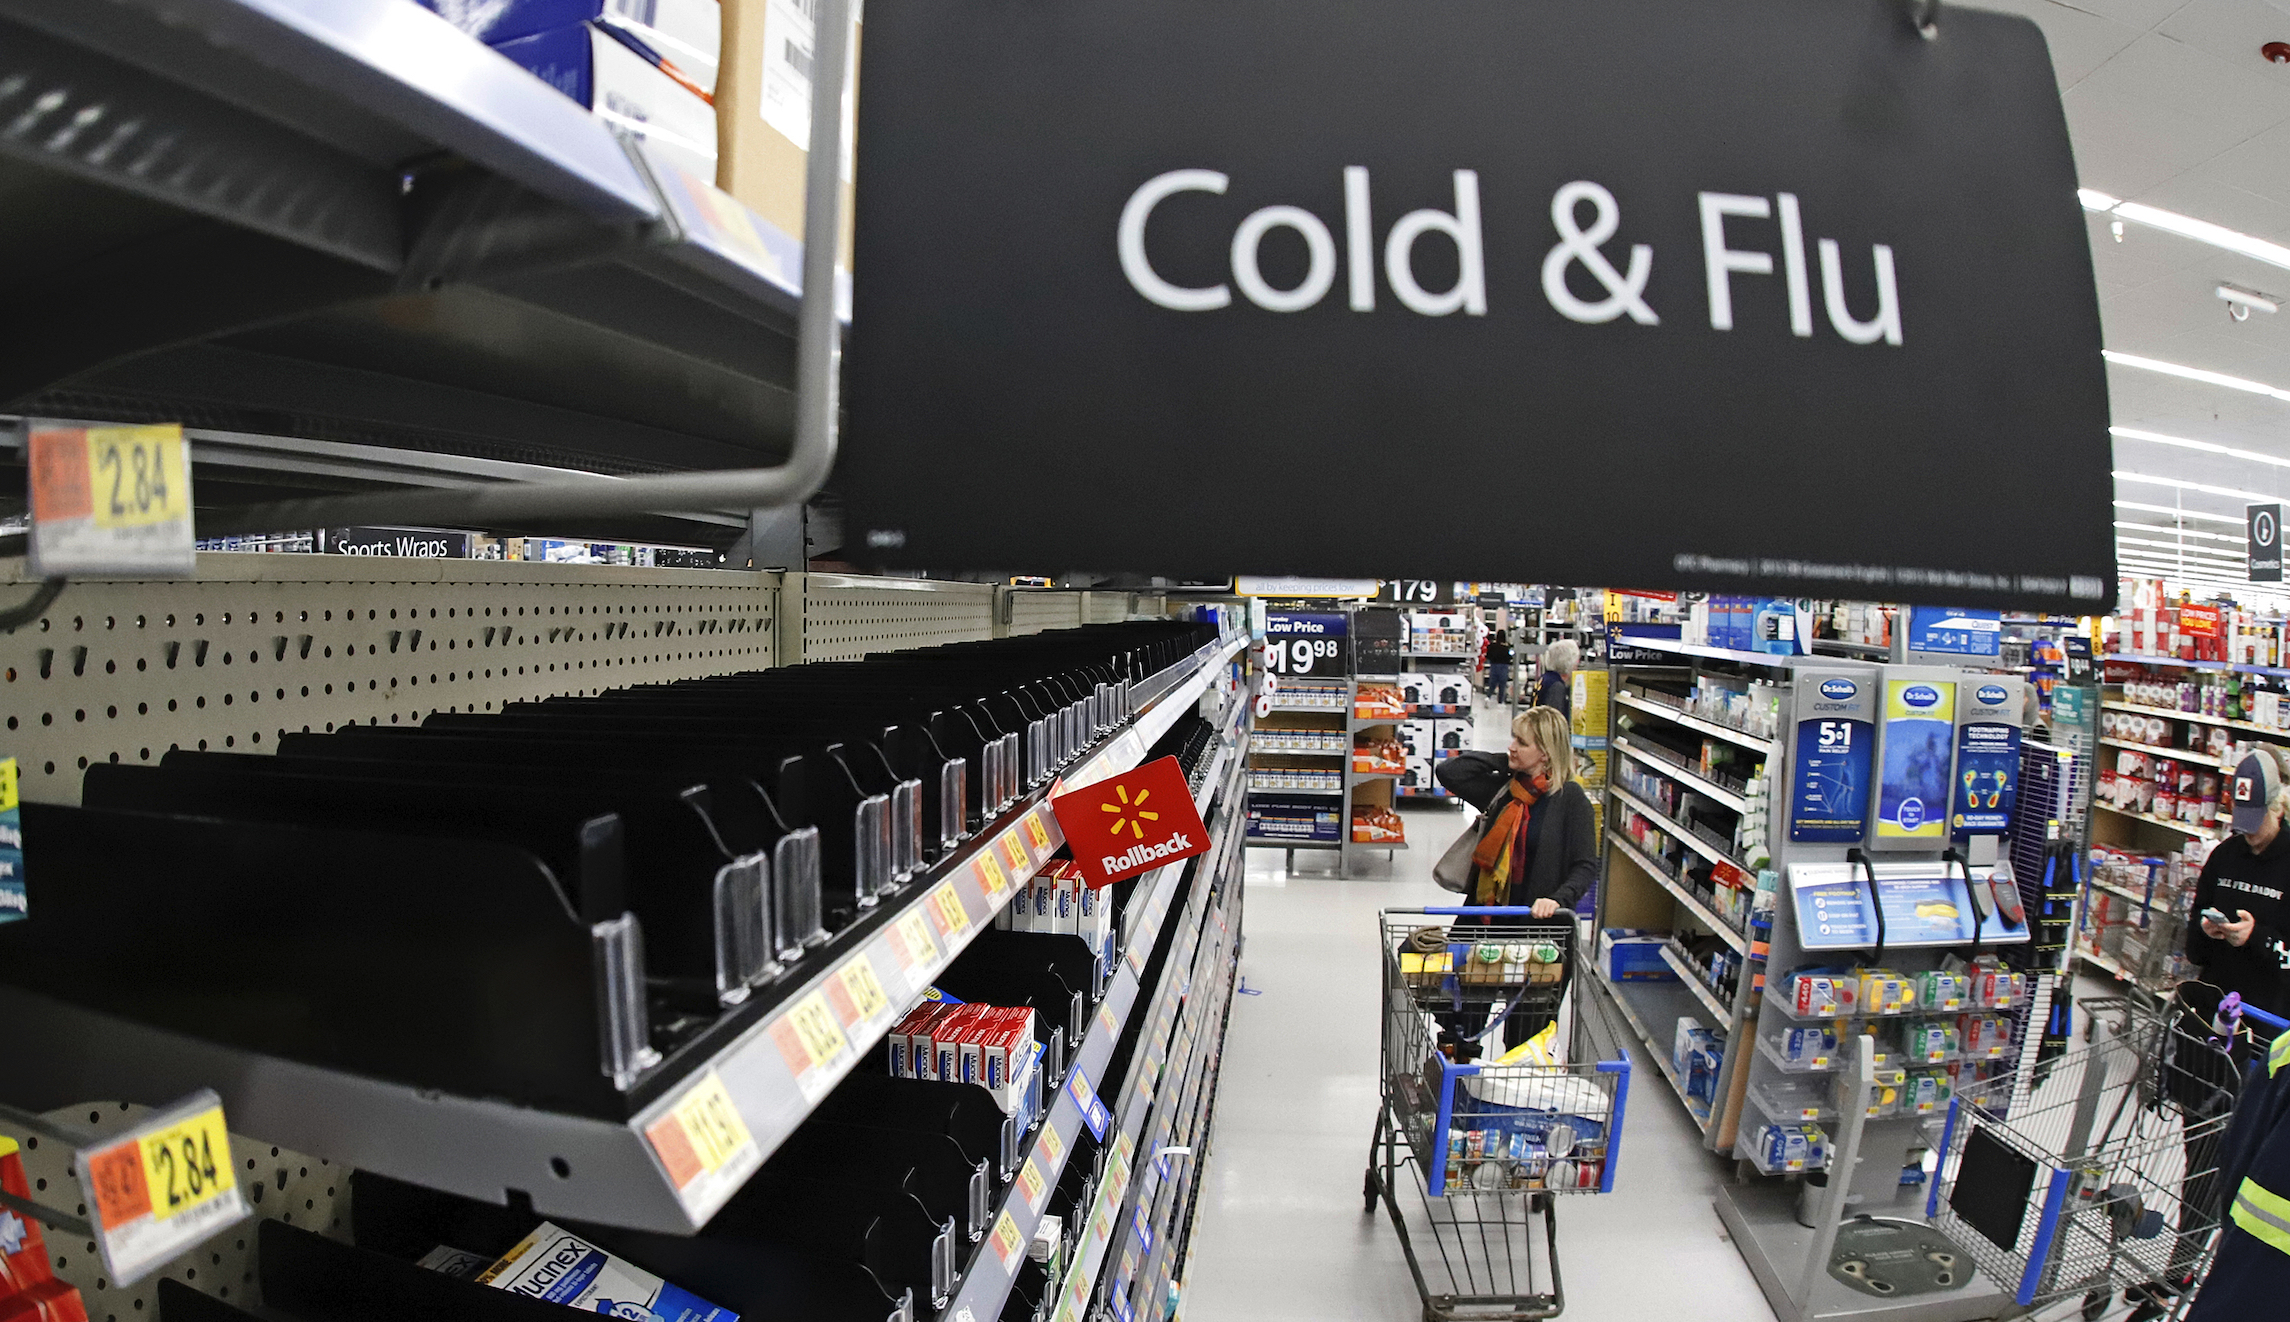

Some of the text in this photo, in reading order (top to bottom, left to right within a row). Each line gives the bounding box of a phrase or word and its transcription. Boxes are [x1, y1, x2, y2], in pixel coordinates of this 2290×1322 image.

[1115, 164, 1905, 347] Cold & Flu
[338, 536, 448, 558] Sports Wraps
[1255, 583, 1266, 591] all
[1267, 583, 1277, 595] by
[1278, 583, 1310, 596] keeping
[1313, 584, 1337, 596] prices
[1266, 621, 1325, 634] Low Price
[1609, 647, 1663, 661] Low Price
[1818, 721, 1837, 746] 5
[1101, 831, 1193, 876] Rollback
[995, 1056, 1003, 1089] Mucinex
